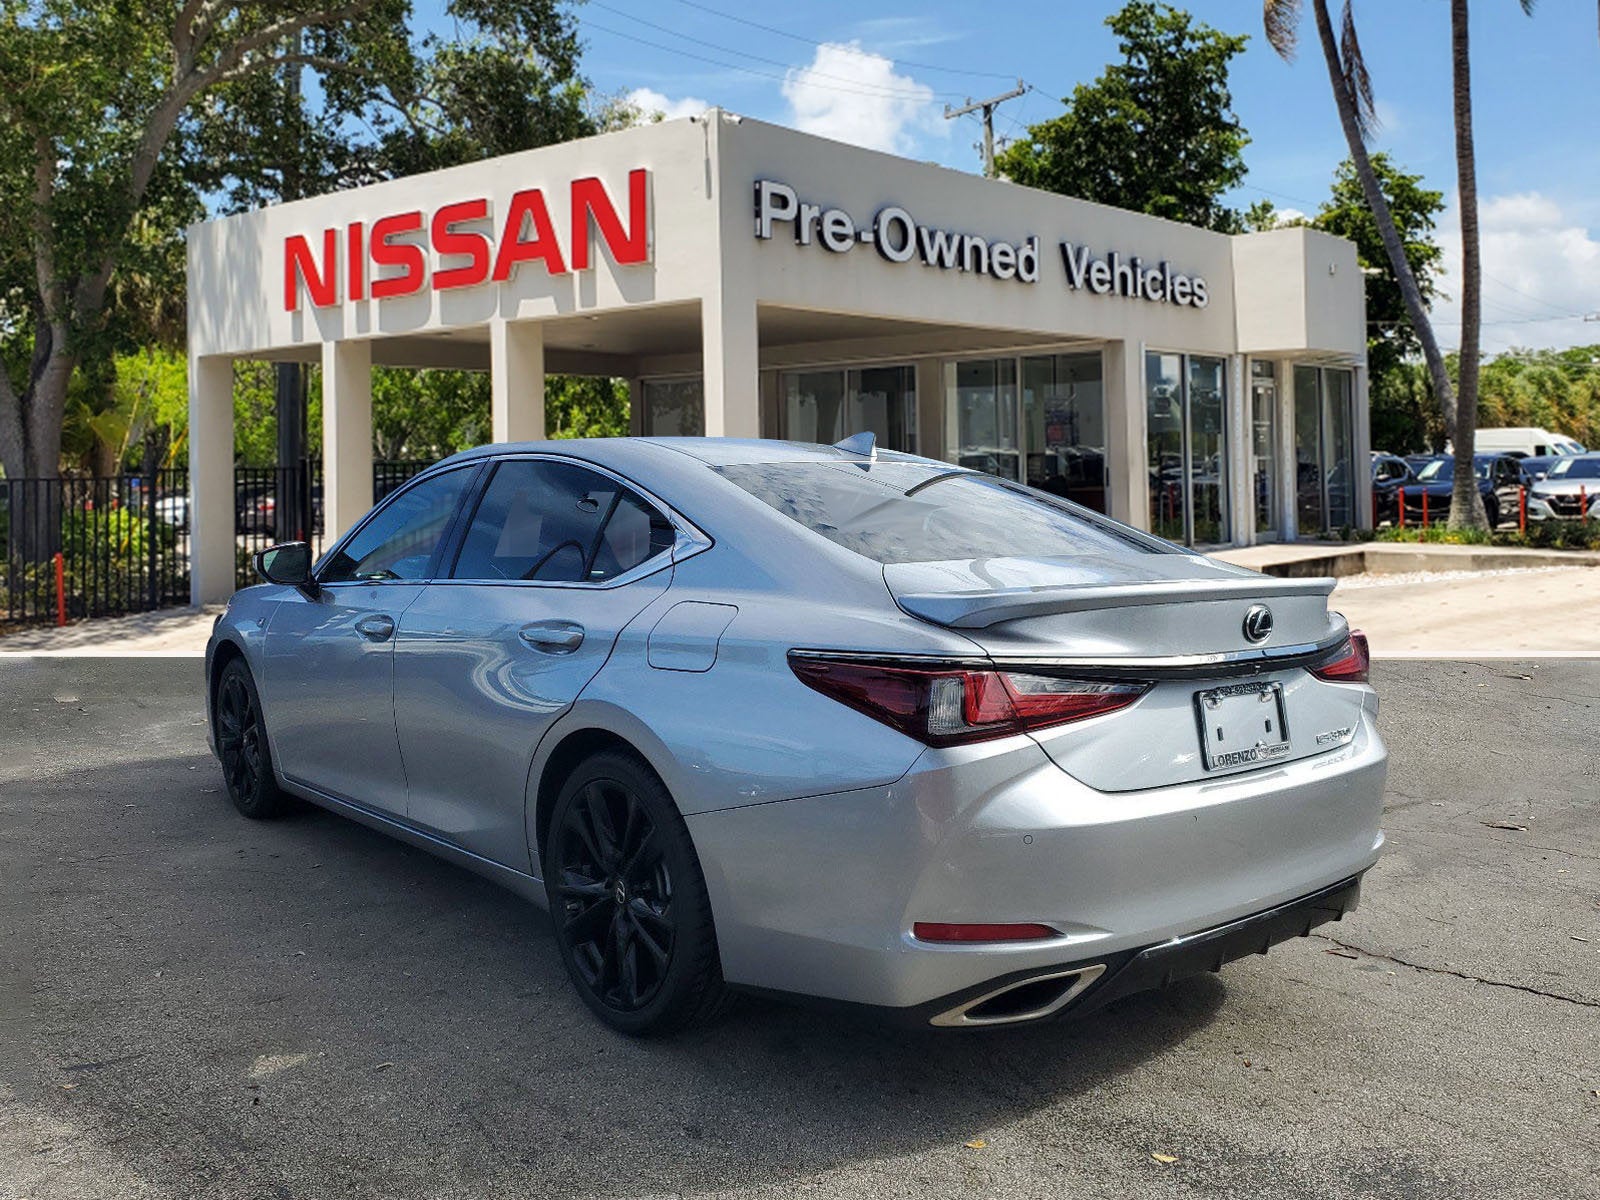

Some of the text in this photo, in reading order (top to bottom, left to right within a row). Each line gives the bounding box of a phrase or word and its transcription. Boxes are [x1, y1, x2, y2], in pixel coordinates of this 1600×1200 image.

[285, 168, 648, 312] NISSAN
[754, 179, 1209, 309] Pre-Owned Vehicles
[1211, 748, 1257, 769] LORENZO
